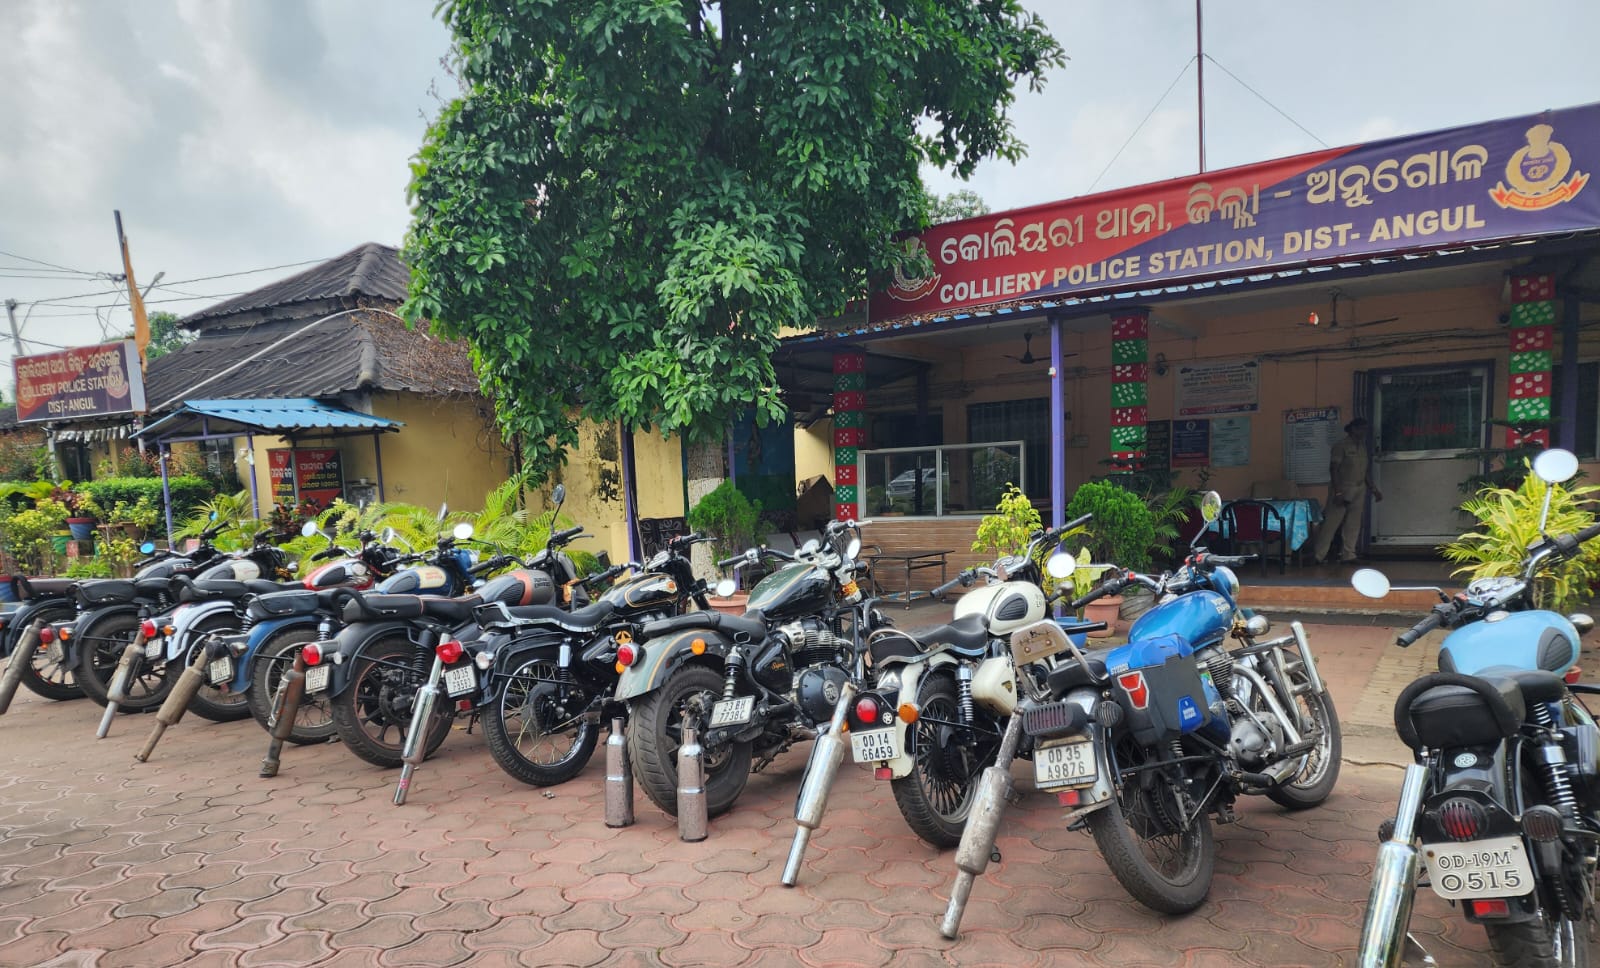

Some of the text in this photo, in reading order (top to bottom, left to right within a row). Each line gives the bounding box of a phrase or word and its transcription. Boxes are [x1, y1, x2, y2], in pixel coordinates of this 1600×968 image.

[940, 214, 1084, 265] କୋଲିୟରୀ
[1095, 201, 1172, 240] ଥାନା,
[1185, 182, 1260, 230] ଜିଲ୍ଲା
[1306, 144, 1489, 208] ଅନୁଗୋଳ
[939, 204, 1486, 304] COLLIERY POLICE STATION, DIST- ANGUL
[21, 374, 121, 399] COLLIERY POLICE STATION
[48, 396, 97, 413] DIST- ANGUL
[723, 701, 734, 712] 23
[877, 732, 889, 746] 14
[862, 745, 893, 761] G6459
[1065, 745, 1081, 761] 35
[1047, 761, 1085, 780] A9876
[1438, 850, 1512, 869] OD-19M
